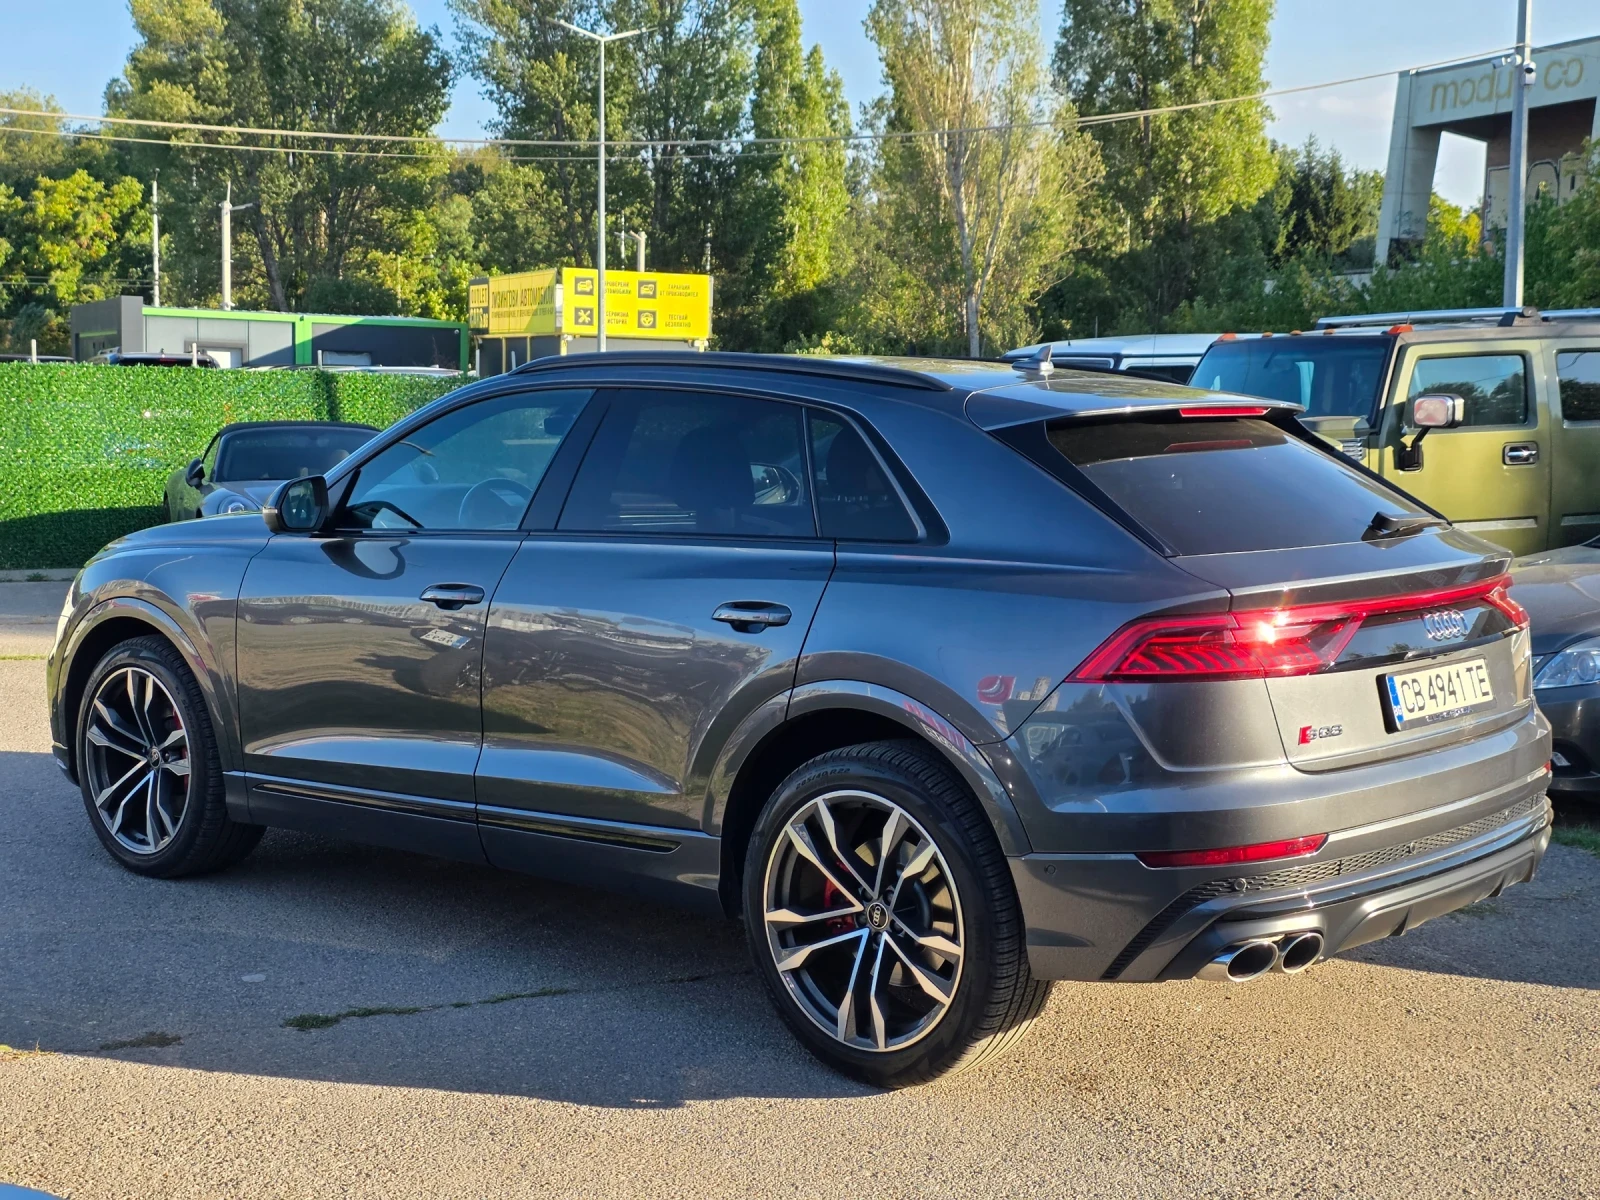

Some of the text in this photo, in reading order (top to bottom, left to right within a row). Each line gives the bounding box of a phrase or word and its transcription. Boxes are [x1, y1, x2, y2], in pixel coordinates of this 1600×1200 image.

[1429, 67, 1519, 112] modu
[471, 287, 488, 304] OUTLET
[1401, 665, 1490, 713] CB 4941 TE
